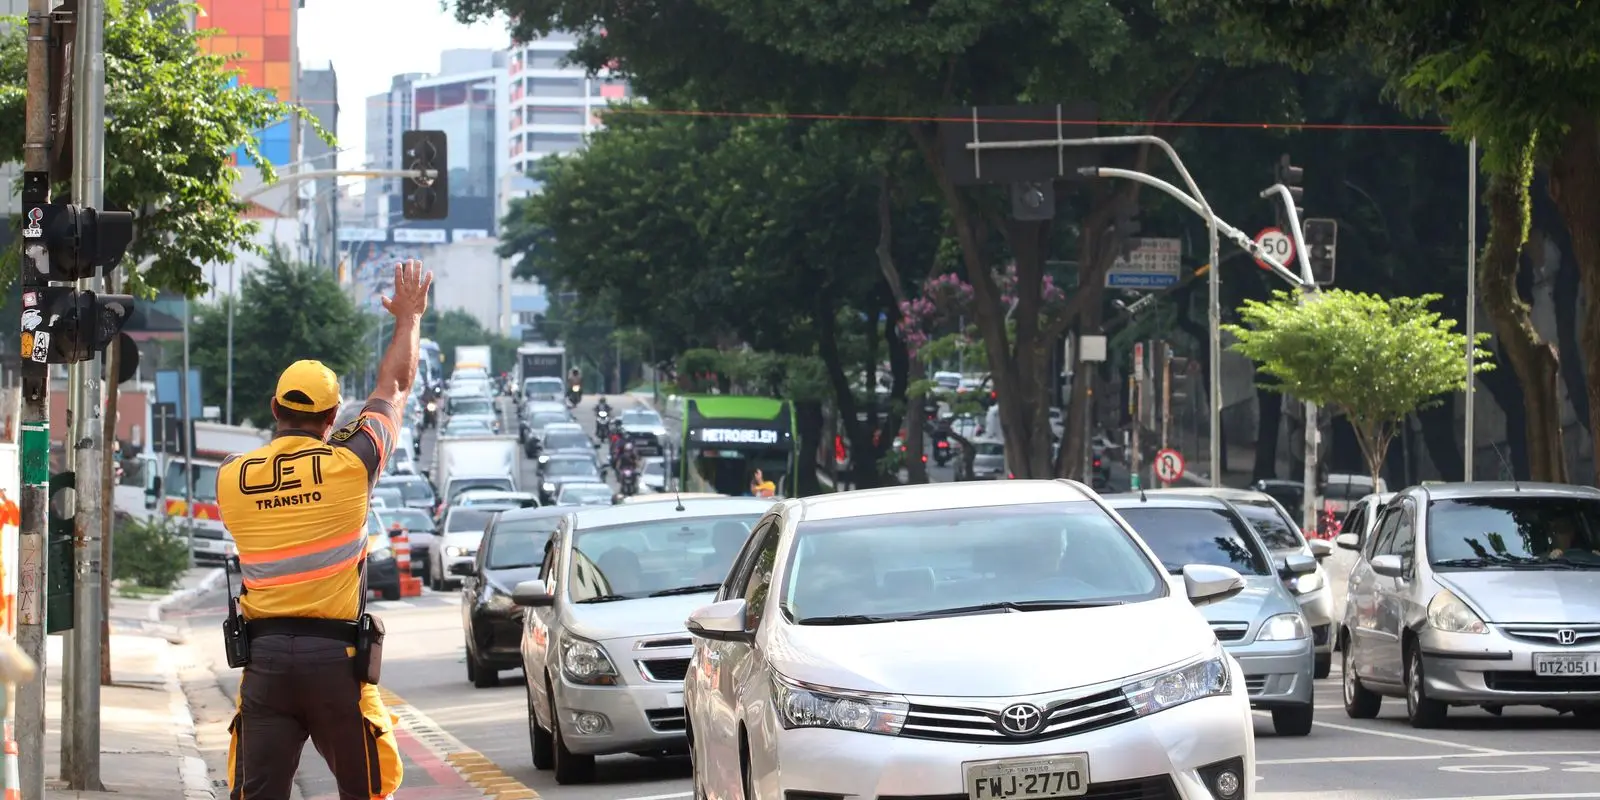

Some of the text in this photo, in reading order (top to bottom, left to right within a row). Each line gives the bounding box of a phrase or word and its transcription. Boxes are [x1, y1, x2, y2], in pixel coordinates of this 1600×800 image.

[1263, 238, 1288, 255] 50
[239, 448, 332, 495] CET
[256, 491, 322, 510] TRÂNSITO
